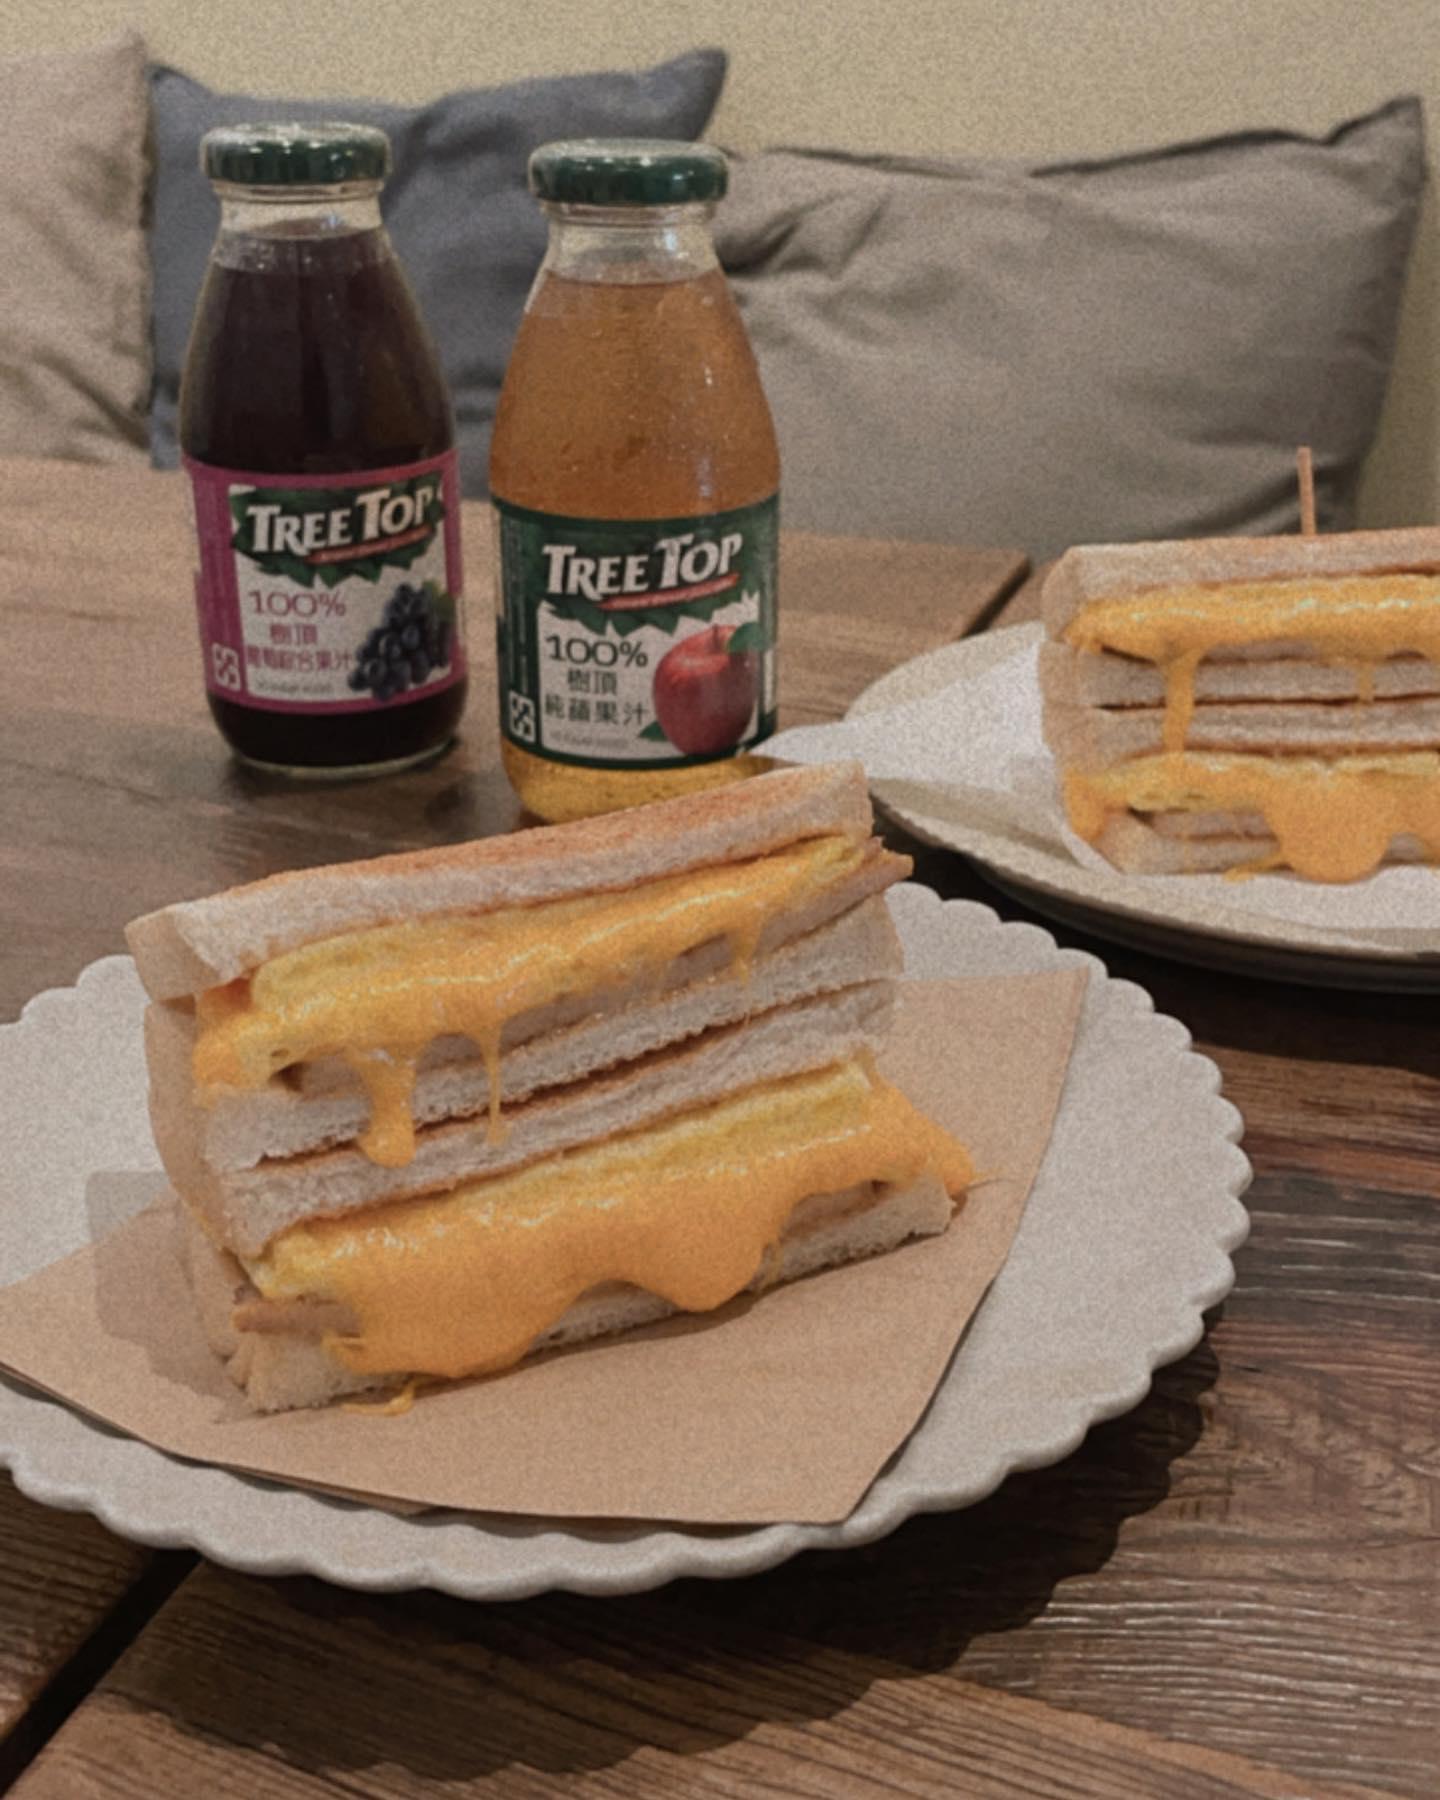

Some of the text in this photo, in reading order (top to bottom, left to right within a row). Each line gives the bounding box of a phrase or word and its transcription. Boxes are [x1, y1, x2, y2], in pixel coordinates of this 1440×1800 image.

[248, 590, 347, 617] 100%
[544, 634, 649, 668] 100%
[567, 667, 618, 696] 樹頂
[544, 693, 649, 726] 純蘋果汁
